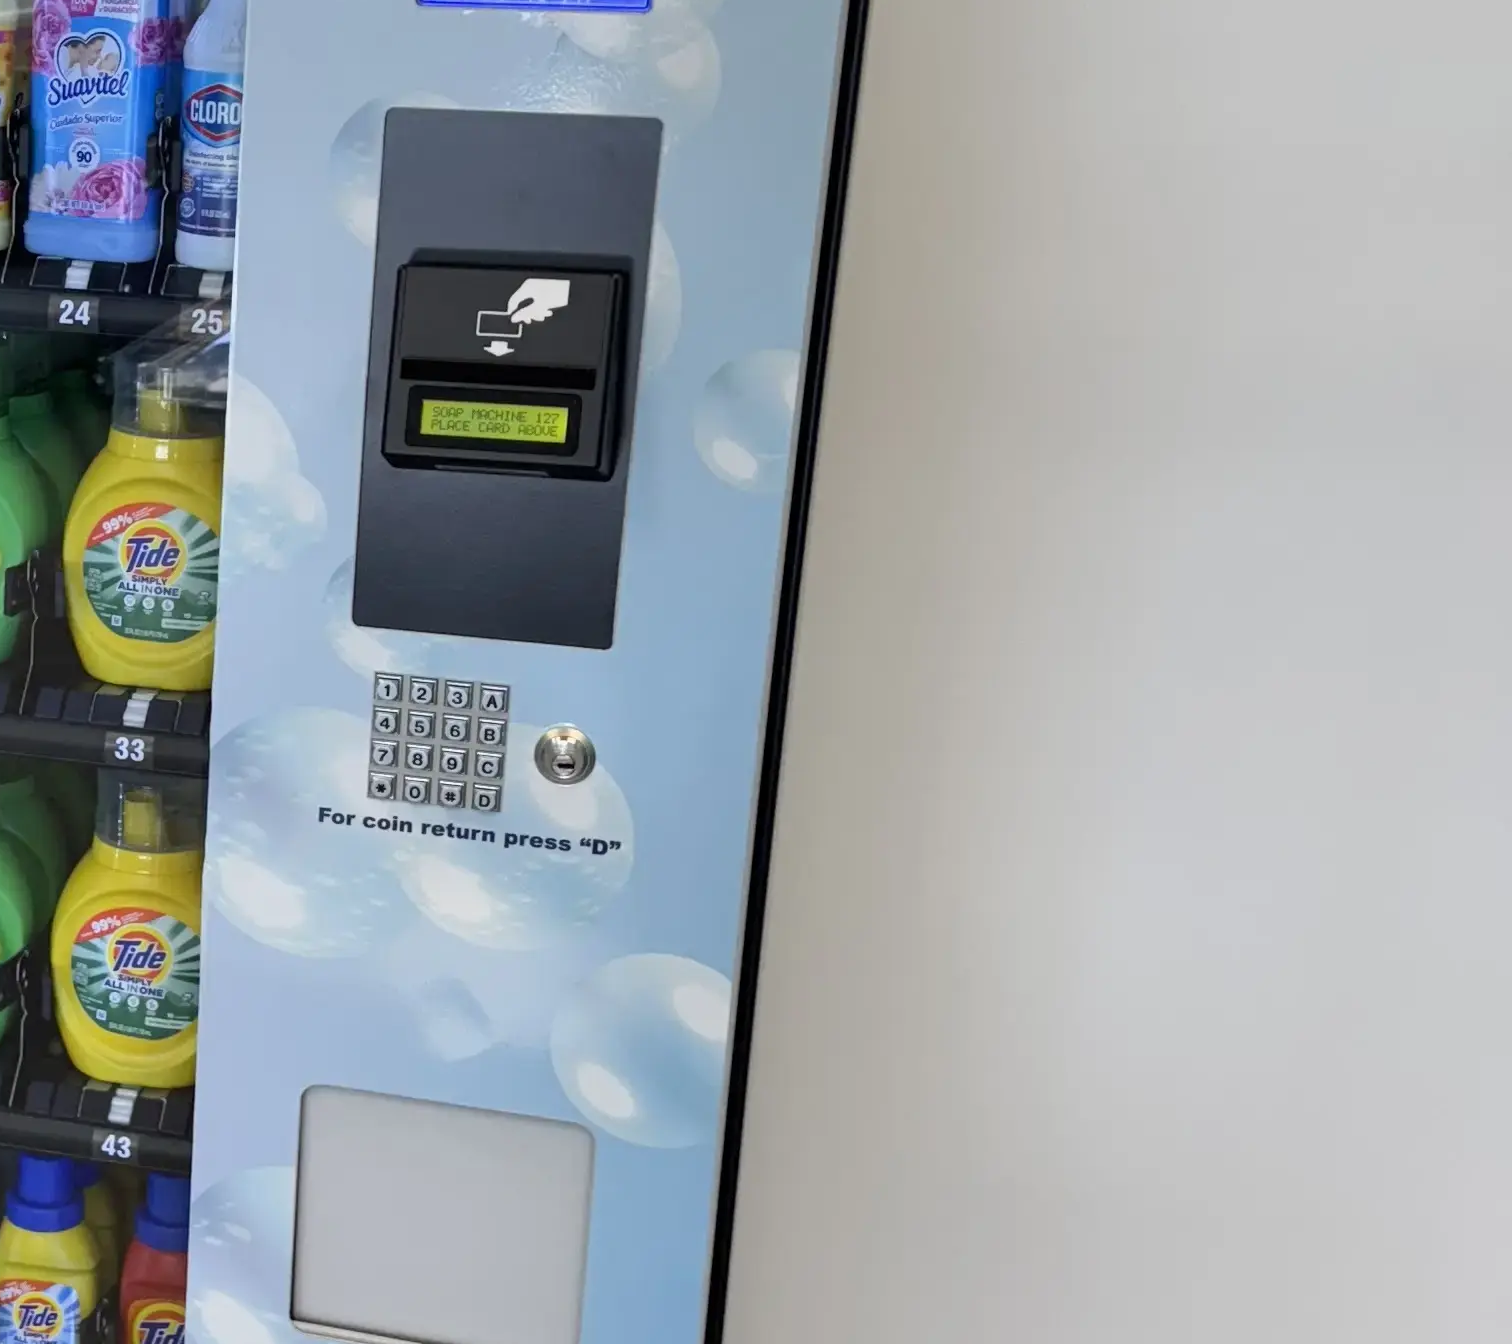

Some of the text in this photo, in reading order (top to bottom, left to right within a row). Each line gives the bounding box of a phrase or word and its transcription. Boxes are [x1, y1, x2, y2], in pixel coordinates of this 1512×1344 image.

[49, 71, 129, 106] Suavitel
[84, 113, 122, 124] Superior
[76, 151, 92, 163] 90
[59, 300, 90, 325] 24
[191, 309, 223, 335] 25
[432, 406, 560, 425] SOAP MACHINE 127
[431, 420, 558, 437] PLACE CARD ABOVE
[102, 512, 133, 533] 99%
[126, 537, 180, 572] Tide
[118, 581, 180, 596] ALL IN ONE
[131, 575, 168, 585] SIMPLY
[383, 683, 498, 709] 1 2 3 A
[380, 717, 495, 742] 4 5 6 B
[114, 736, 145, 762] 33
[378, 749, 493, 775] 7 8 9 C
[479, 794, 490, 807] D
[318, 806, 356, 826] For
[363, 813, 413, 833] coin
[421, 822, 496, 843] return
[504, 831, 571, 852] press
[91, 915, 121, 933] 99%
[113, 940, 166, 971] Tide
[104, 979, 164, 997] ALL IN ONE
[118, 974, 153, 986] SIMPLY
[101, 1134, 131, 1158] 43
[19, 1305, 58, 1329] Tide
